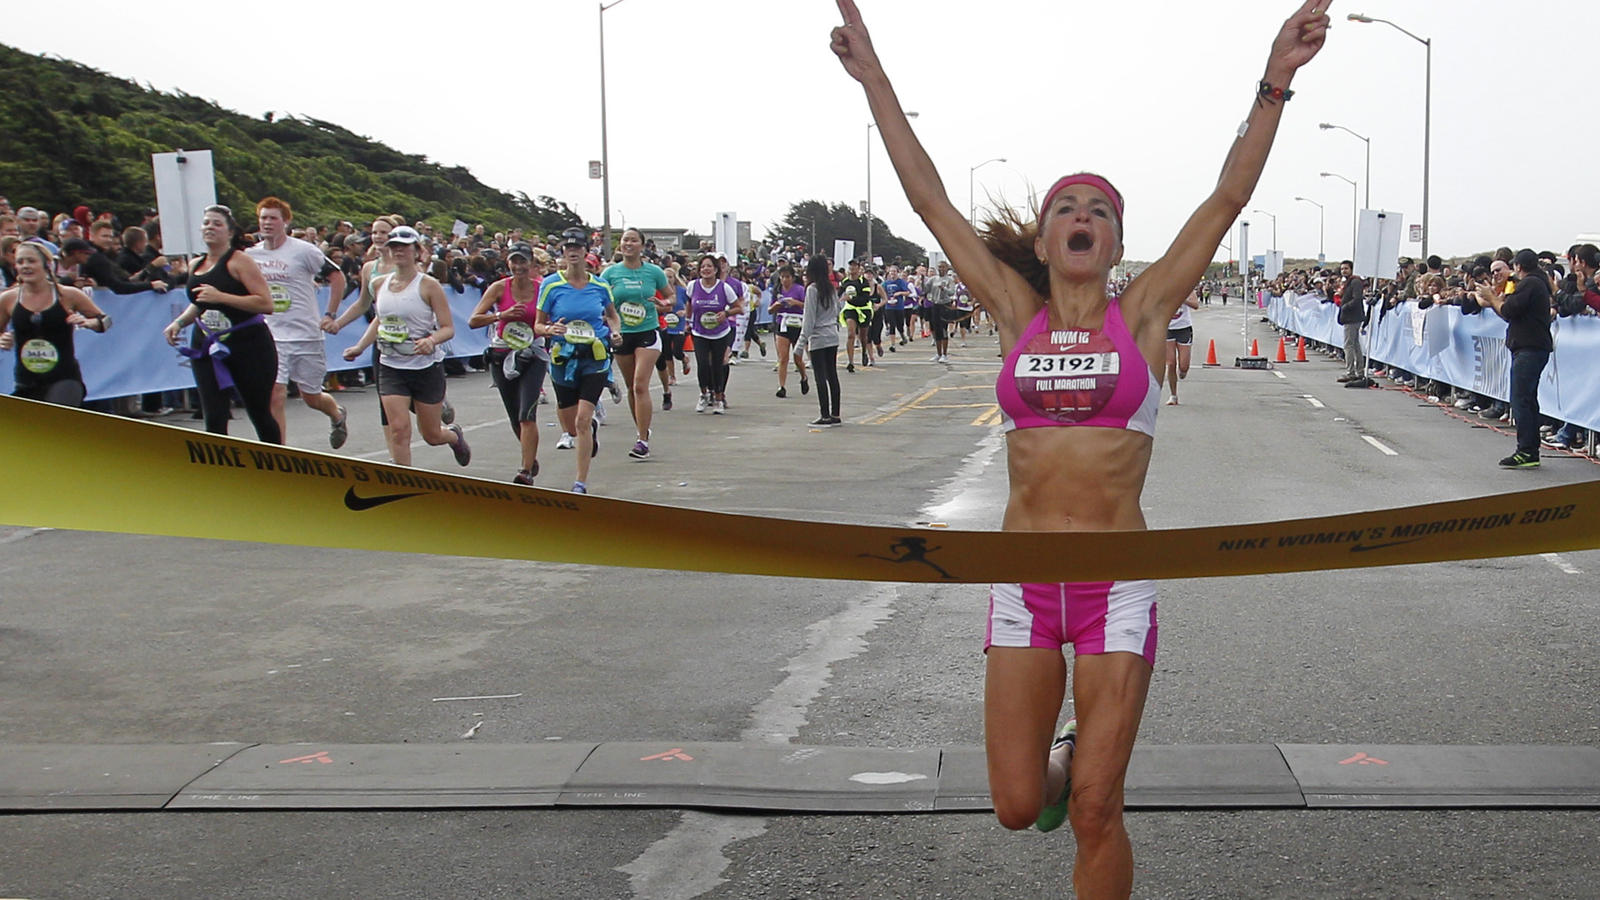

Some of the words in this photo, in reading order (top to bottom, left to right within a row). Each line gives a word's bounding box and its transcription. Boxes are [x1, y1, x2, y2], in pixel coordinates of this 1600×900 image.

[1029, 357, 1095, 372] 23192
[1036, 379, 1053, 391] FULL
[1054, 378, 1096, 390] MARATHON
[185, 440, 246, 468] NIKE
[250, 451, 369, 482] WOMEN'S
[374, 469, 513, 501] MARATHON
[519, 494, 580, 511] 2012
[1218, 537, 1271, 550] NIKE
[1277, 527, 1386, 547] WOMEN'S
[1390, 512, 1516, 538] MARATHON
[1520, 504, 1576, 524] 2012
